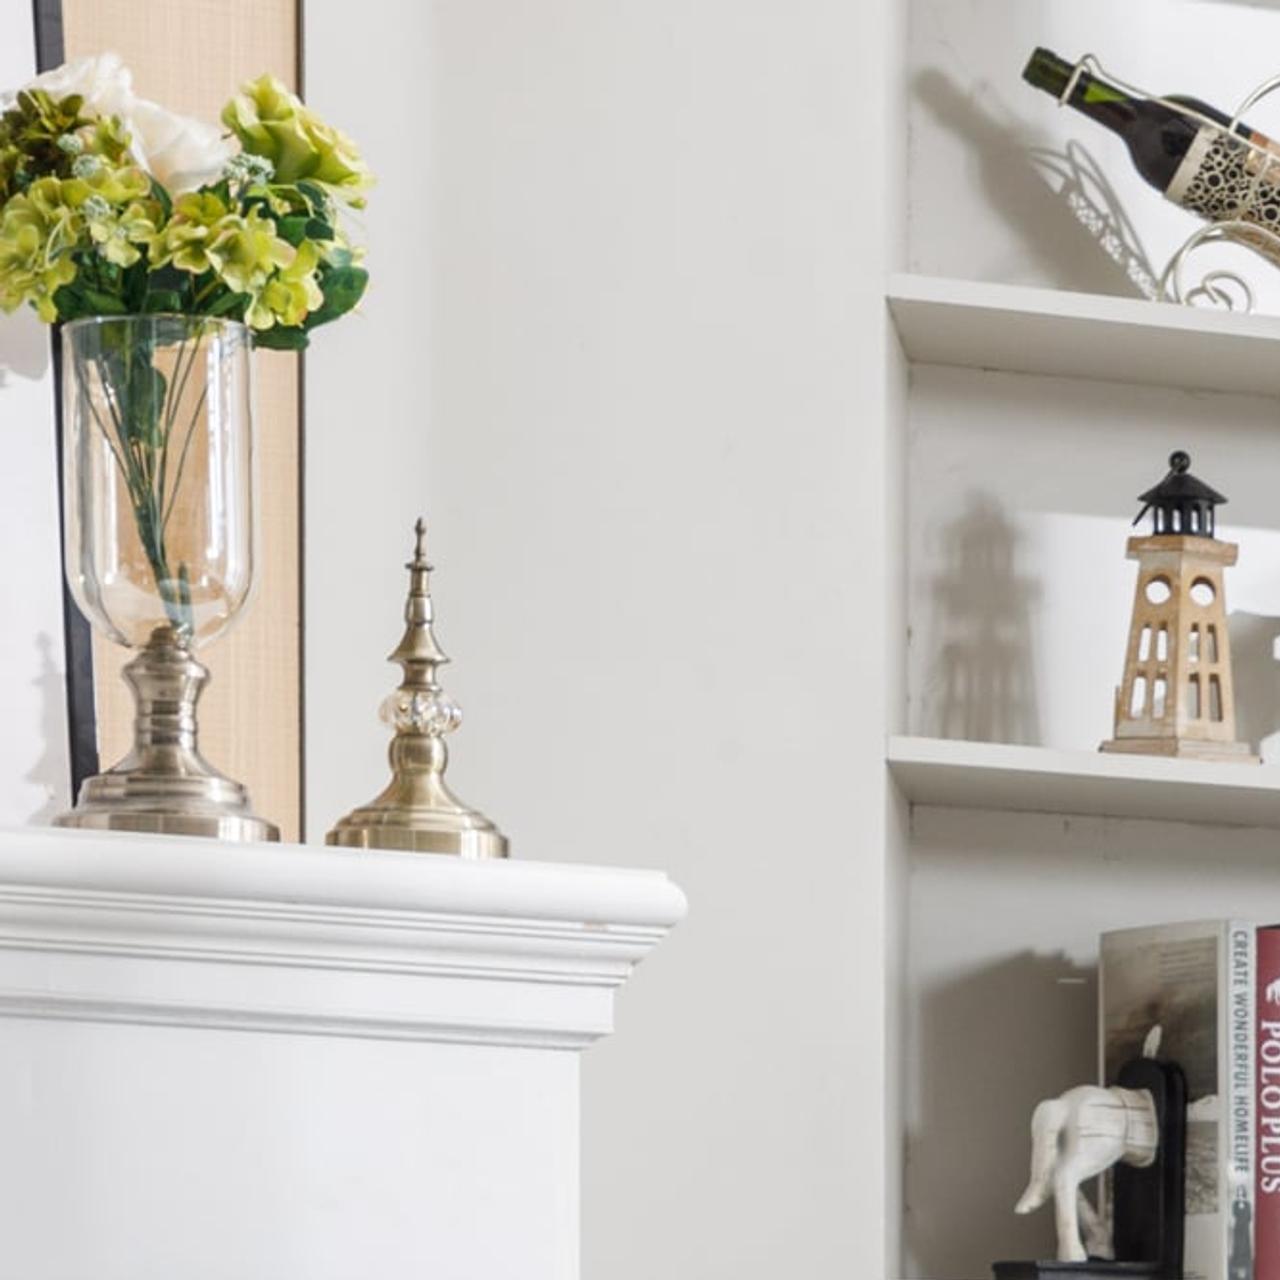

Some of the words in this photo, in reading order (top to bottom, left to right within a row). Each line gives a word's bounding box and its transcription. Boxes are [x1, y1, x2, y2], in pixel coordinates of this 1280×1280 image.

[1232, 930, 1248, 985] CREATE
[1232, 990, 1249, 1089] WONDERFUL
[1233, 1093, 1250, 1172] HOMELIFE
